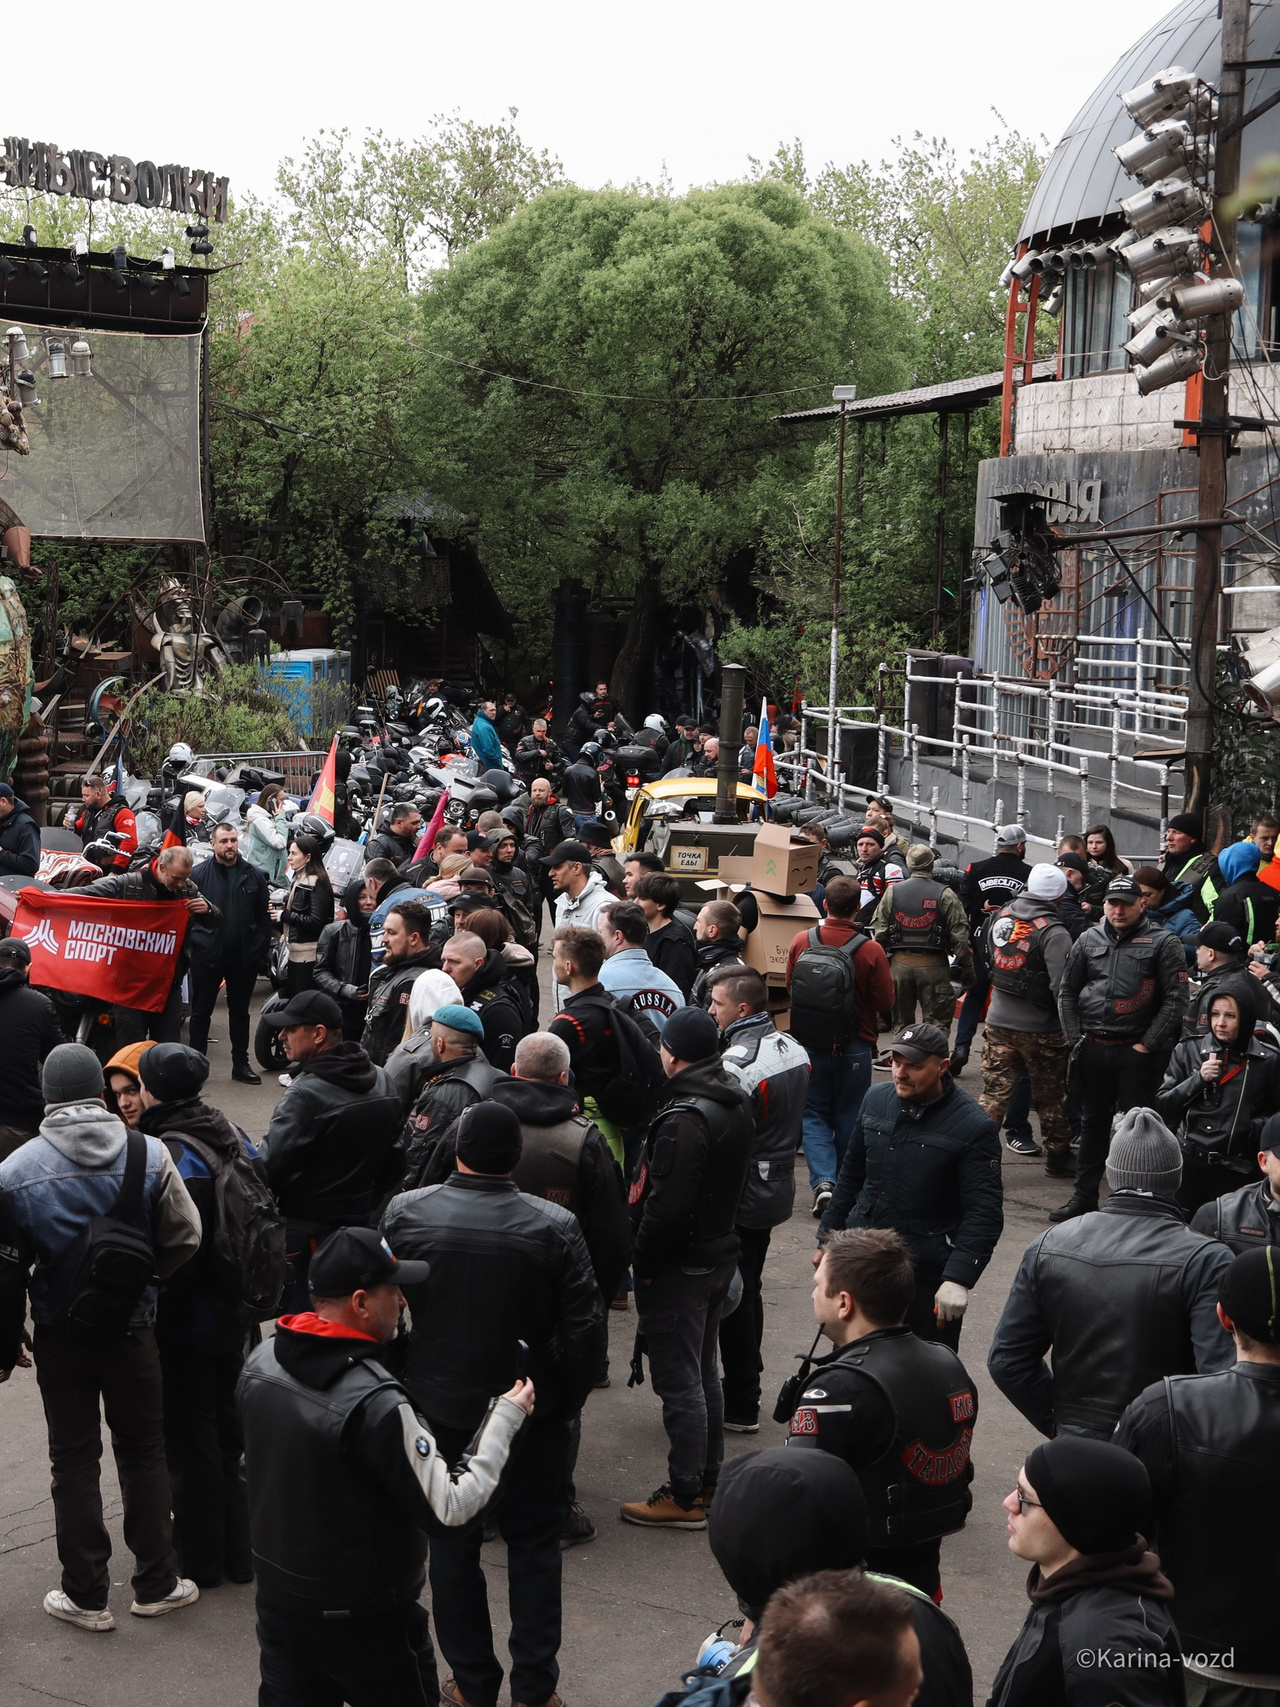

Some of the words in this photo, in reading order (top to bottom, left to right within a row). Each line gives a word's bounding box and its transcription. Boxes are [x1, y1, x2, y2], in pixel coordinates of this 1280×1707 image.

[995, 479, 1102, 523] СИЯ
[980, 878, 1021, 889] IMBECILITY
[64, 940, 118, 965] СПОРТ
[67, 920, 177, 955] МОСКОВСКИЙ
